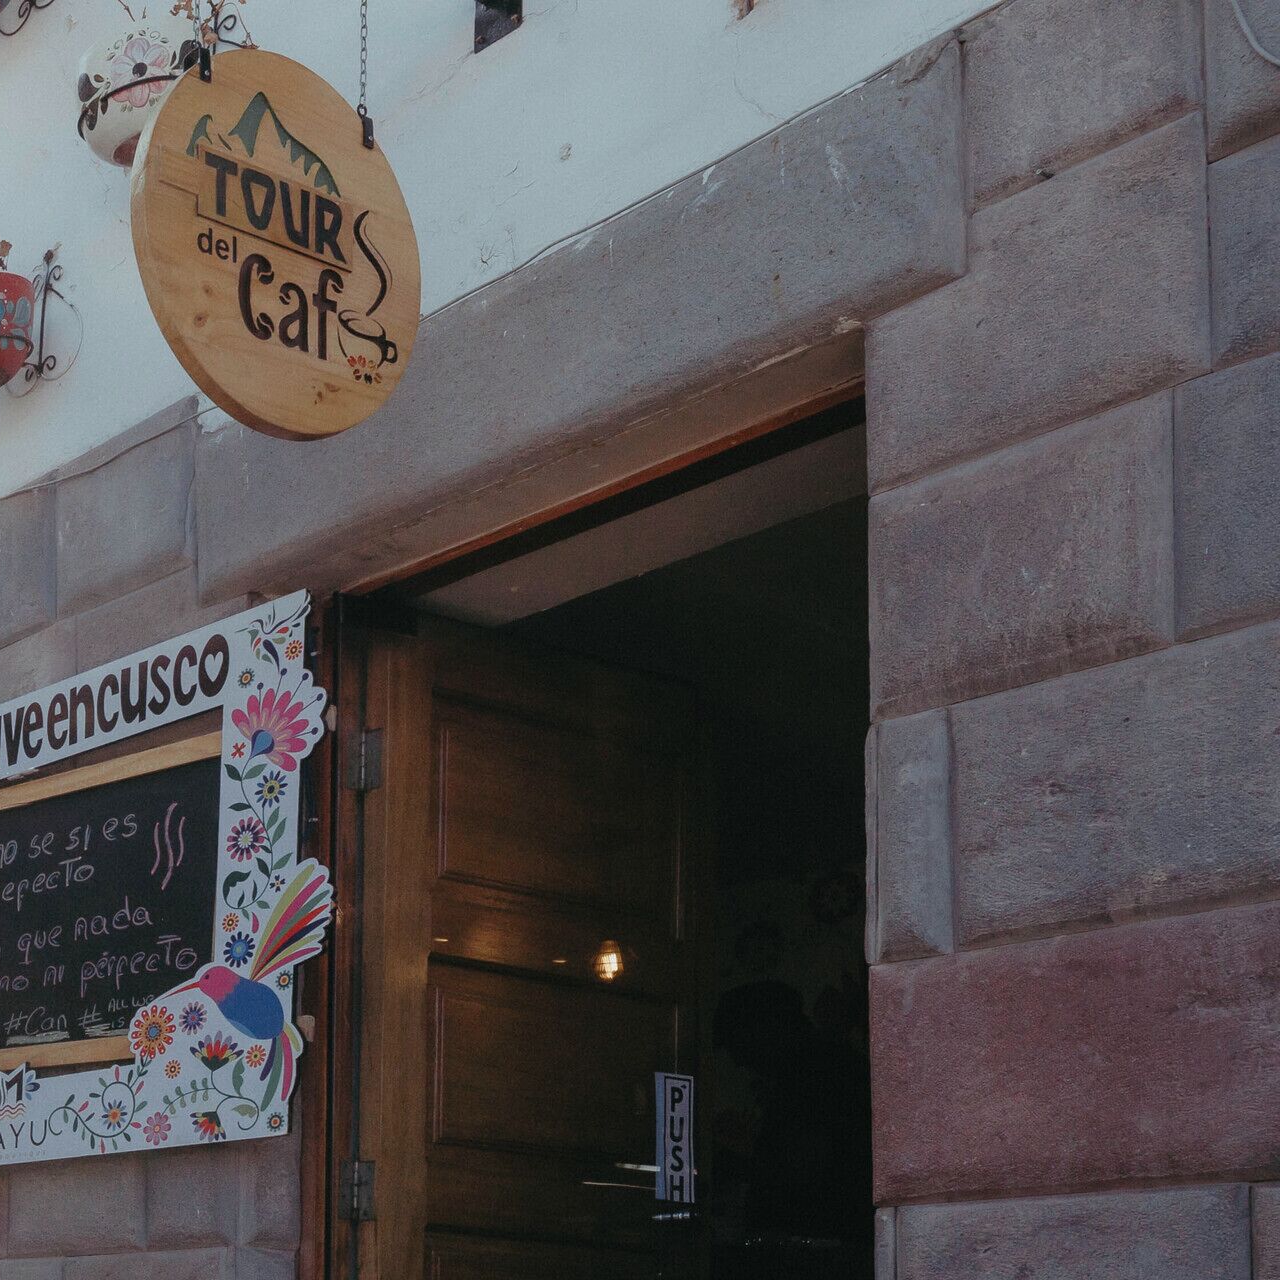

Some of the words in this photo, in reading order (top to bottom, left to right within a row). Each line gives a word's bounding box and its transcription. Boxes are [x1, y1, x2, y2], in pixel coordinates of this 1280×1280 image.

[204, 152, 347, 265] TOUR
[197, 228, 238, 264] del
[28, 832, 55, 858] se
[102, 813, 138, 841] es
[17, 925, 63, 966] que
[73, 895, 154, 942] nada
[669, 1086, 685, 1201] PUSH
